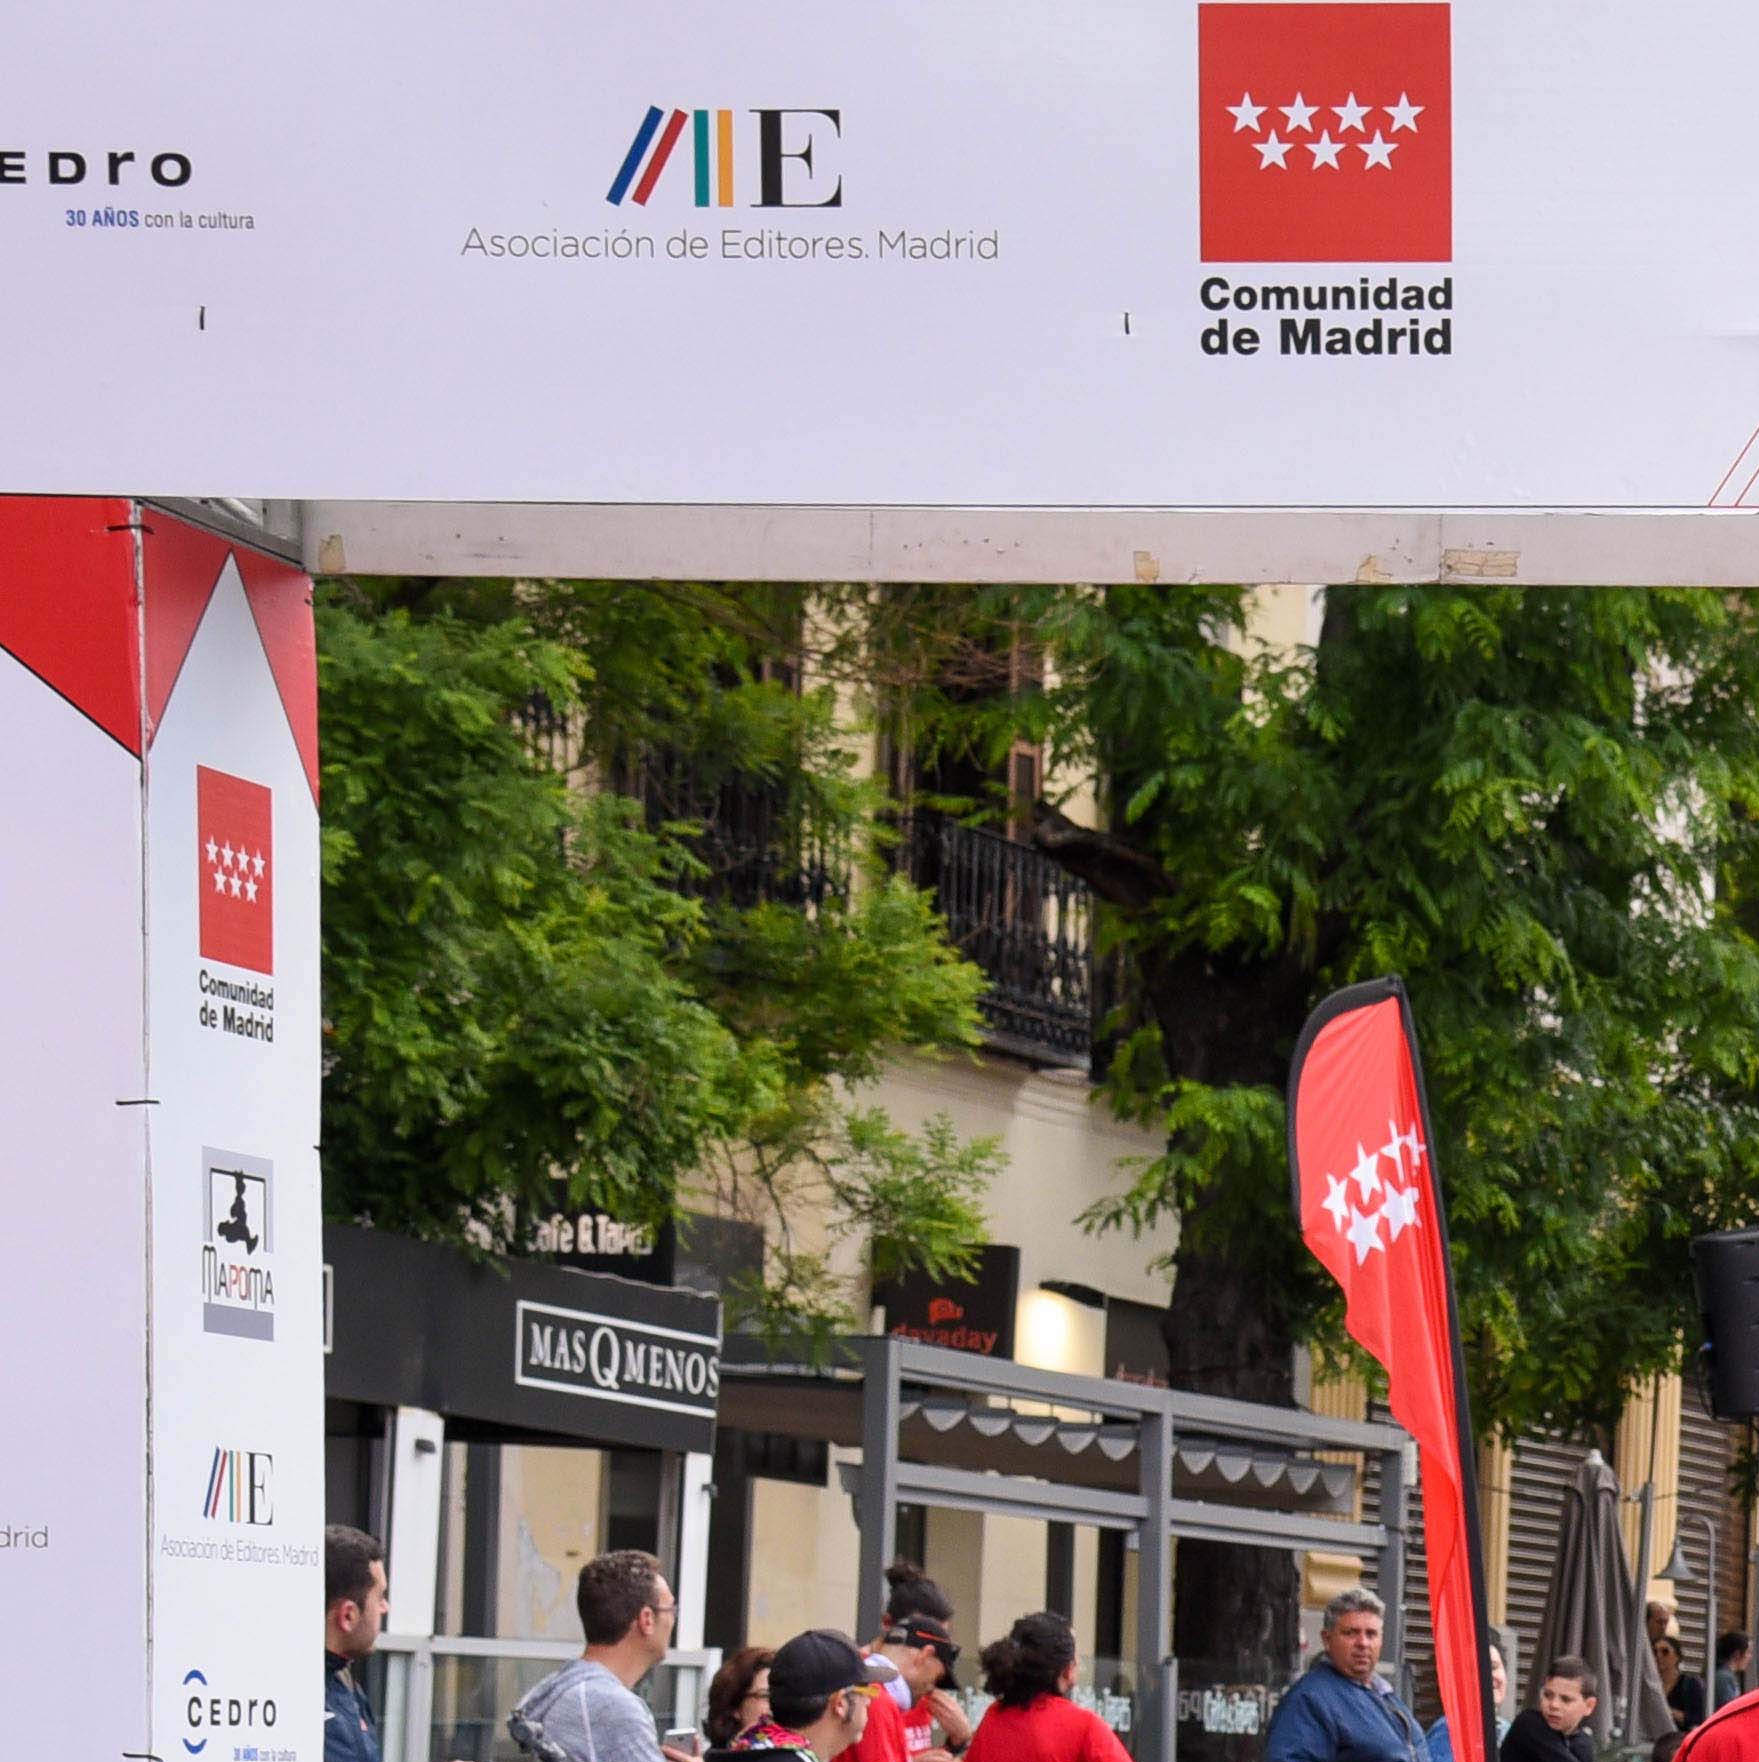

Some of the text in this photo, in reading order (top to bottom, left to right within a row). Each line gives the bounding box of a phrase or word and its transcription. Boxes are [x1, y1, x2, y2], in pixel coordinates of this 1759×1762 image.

[65, 205, 255, 232] 30 AÑOS con la cultura
[461, 226, 655, 261] Asociación
[667, 230, 709, 260] de
[879, 230, 999, 261] Madrid
[1200, 277, 1453, 312] Comunidad
[1200, 318, 1453, 356] de Madrid
[200, 969, 274, 1011] Comunidad
[200, 1001, 274, 1043] de Madrid
[203, 1245, 274, 1310] MAPOMA
